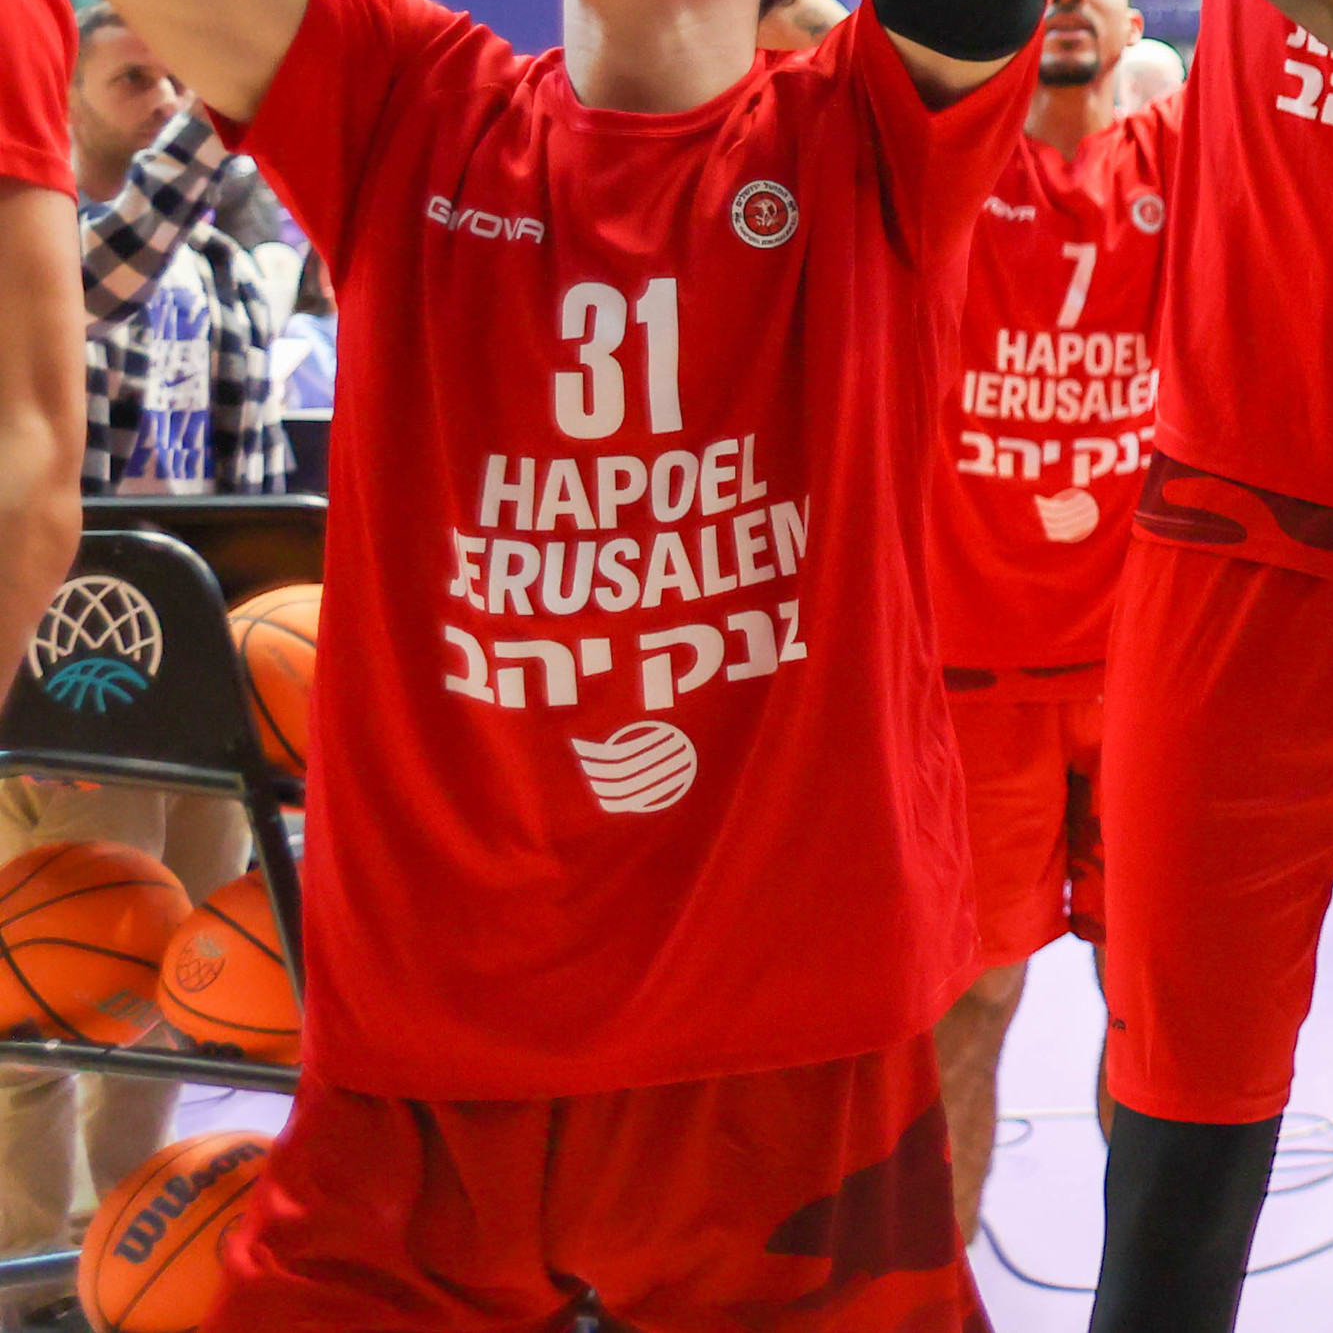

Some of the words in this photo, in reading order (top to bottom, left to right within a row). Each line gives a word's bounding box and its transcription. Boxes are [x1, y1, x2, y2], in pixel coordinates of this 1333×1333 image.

[1056, 241, 1098, 329] 7
[553, 277, 683, 440] 31
[996, 328, 1153, 378] HAPOEL
[479, 433, 768, 531] HAPOEL
[957, 429, 1061, 481] יהב
[443, 624, 613, 710] יהב
[113, 1143, 267, 1265] Wilson
